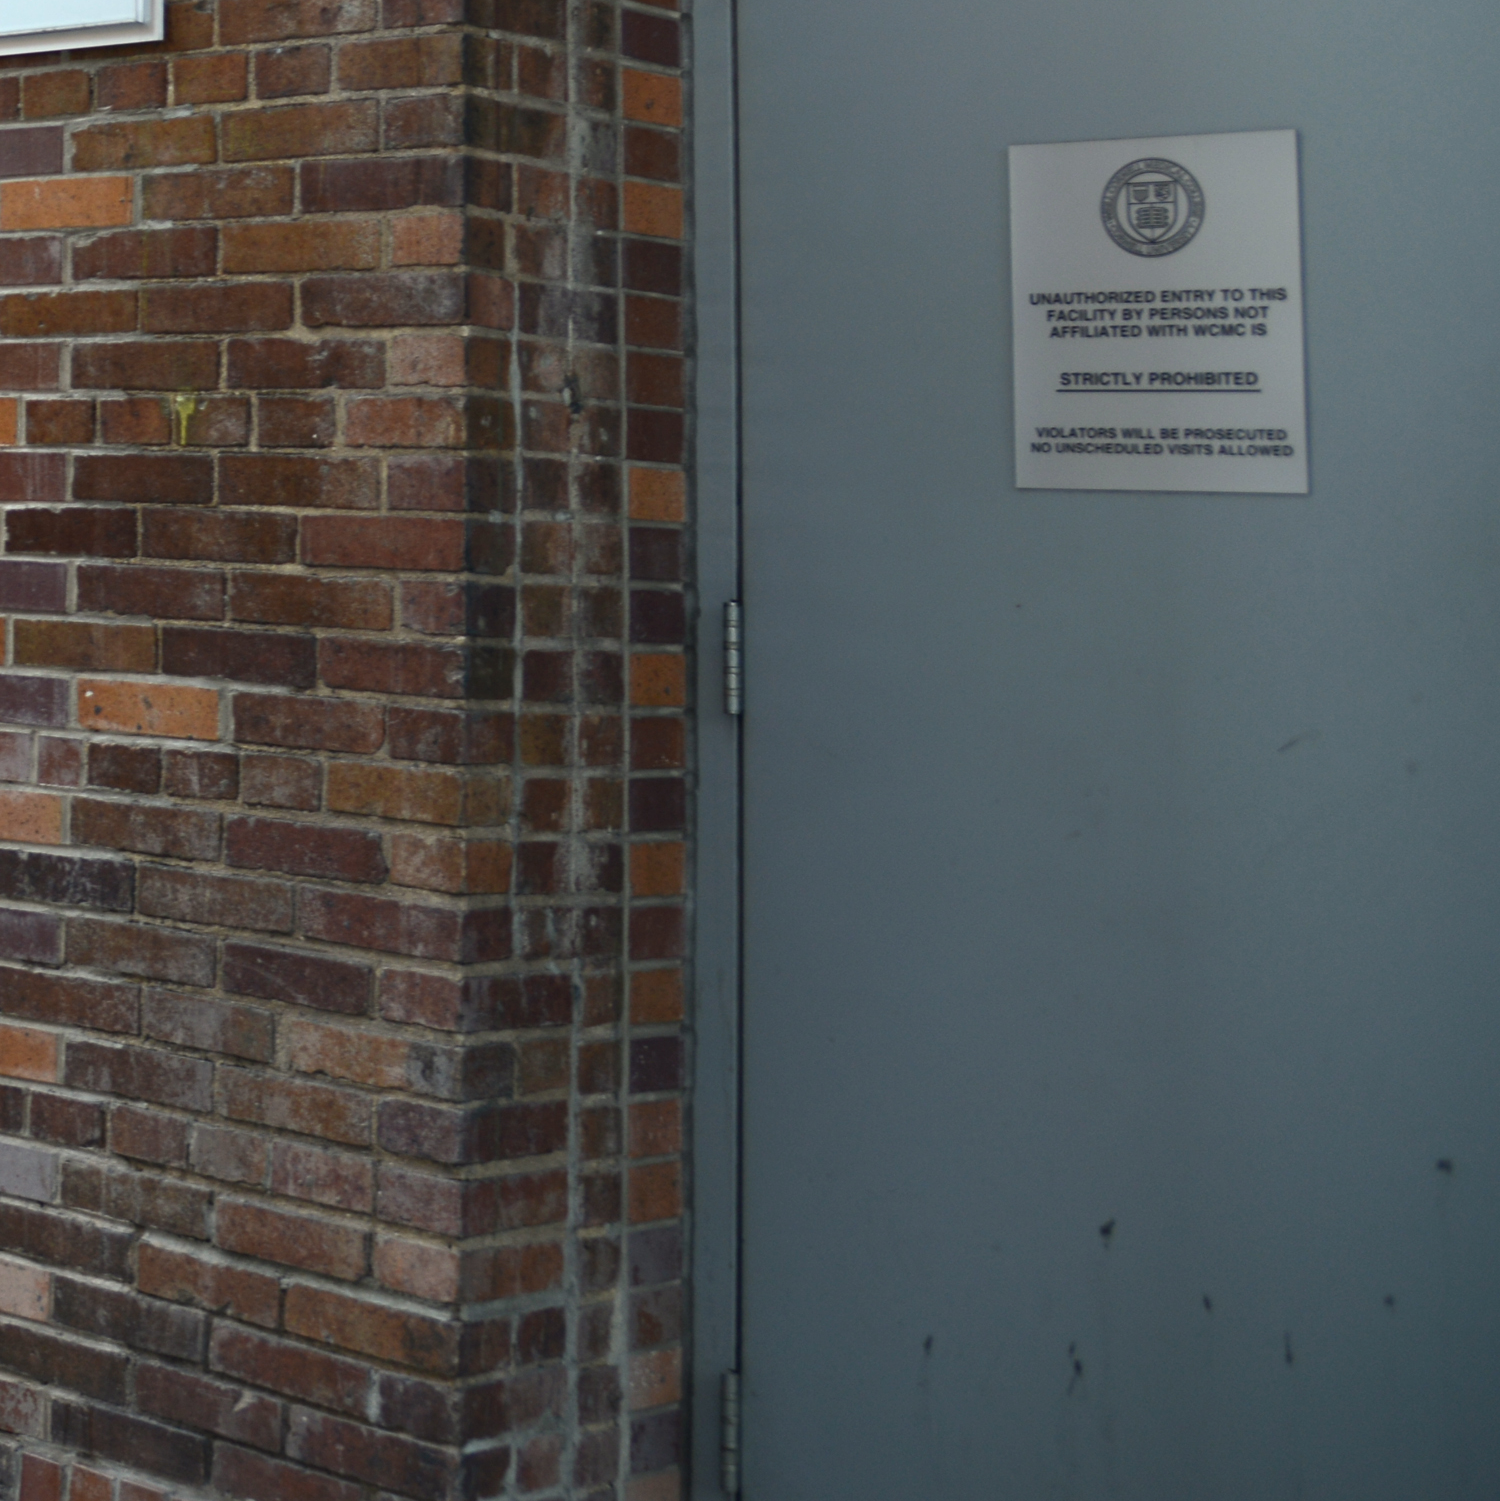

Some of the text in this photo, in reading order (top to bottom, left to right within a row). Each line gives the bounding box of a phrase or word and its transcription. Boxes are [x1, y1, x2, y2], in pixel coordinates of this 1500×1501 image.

[1029, 287, 1288, 306] UNAUTHORIZED ENTRY TO THIS
[1046, 306, 1269, 322] FACILITY BY PERSONS NOT
[1050, 323, 1267, 338] AFFILIATED WITH WCMC IS
[1059, 372, 1259, 386] STRICTLY PROHIBITED
[1035, 427, 1288, 441] VIOLATORS WILL BE PROSECUTED
[1030, 442, 1295, 457] NO UNSCHEDULED VISITS ALLOWED
